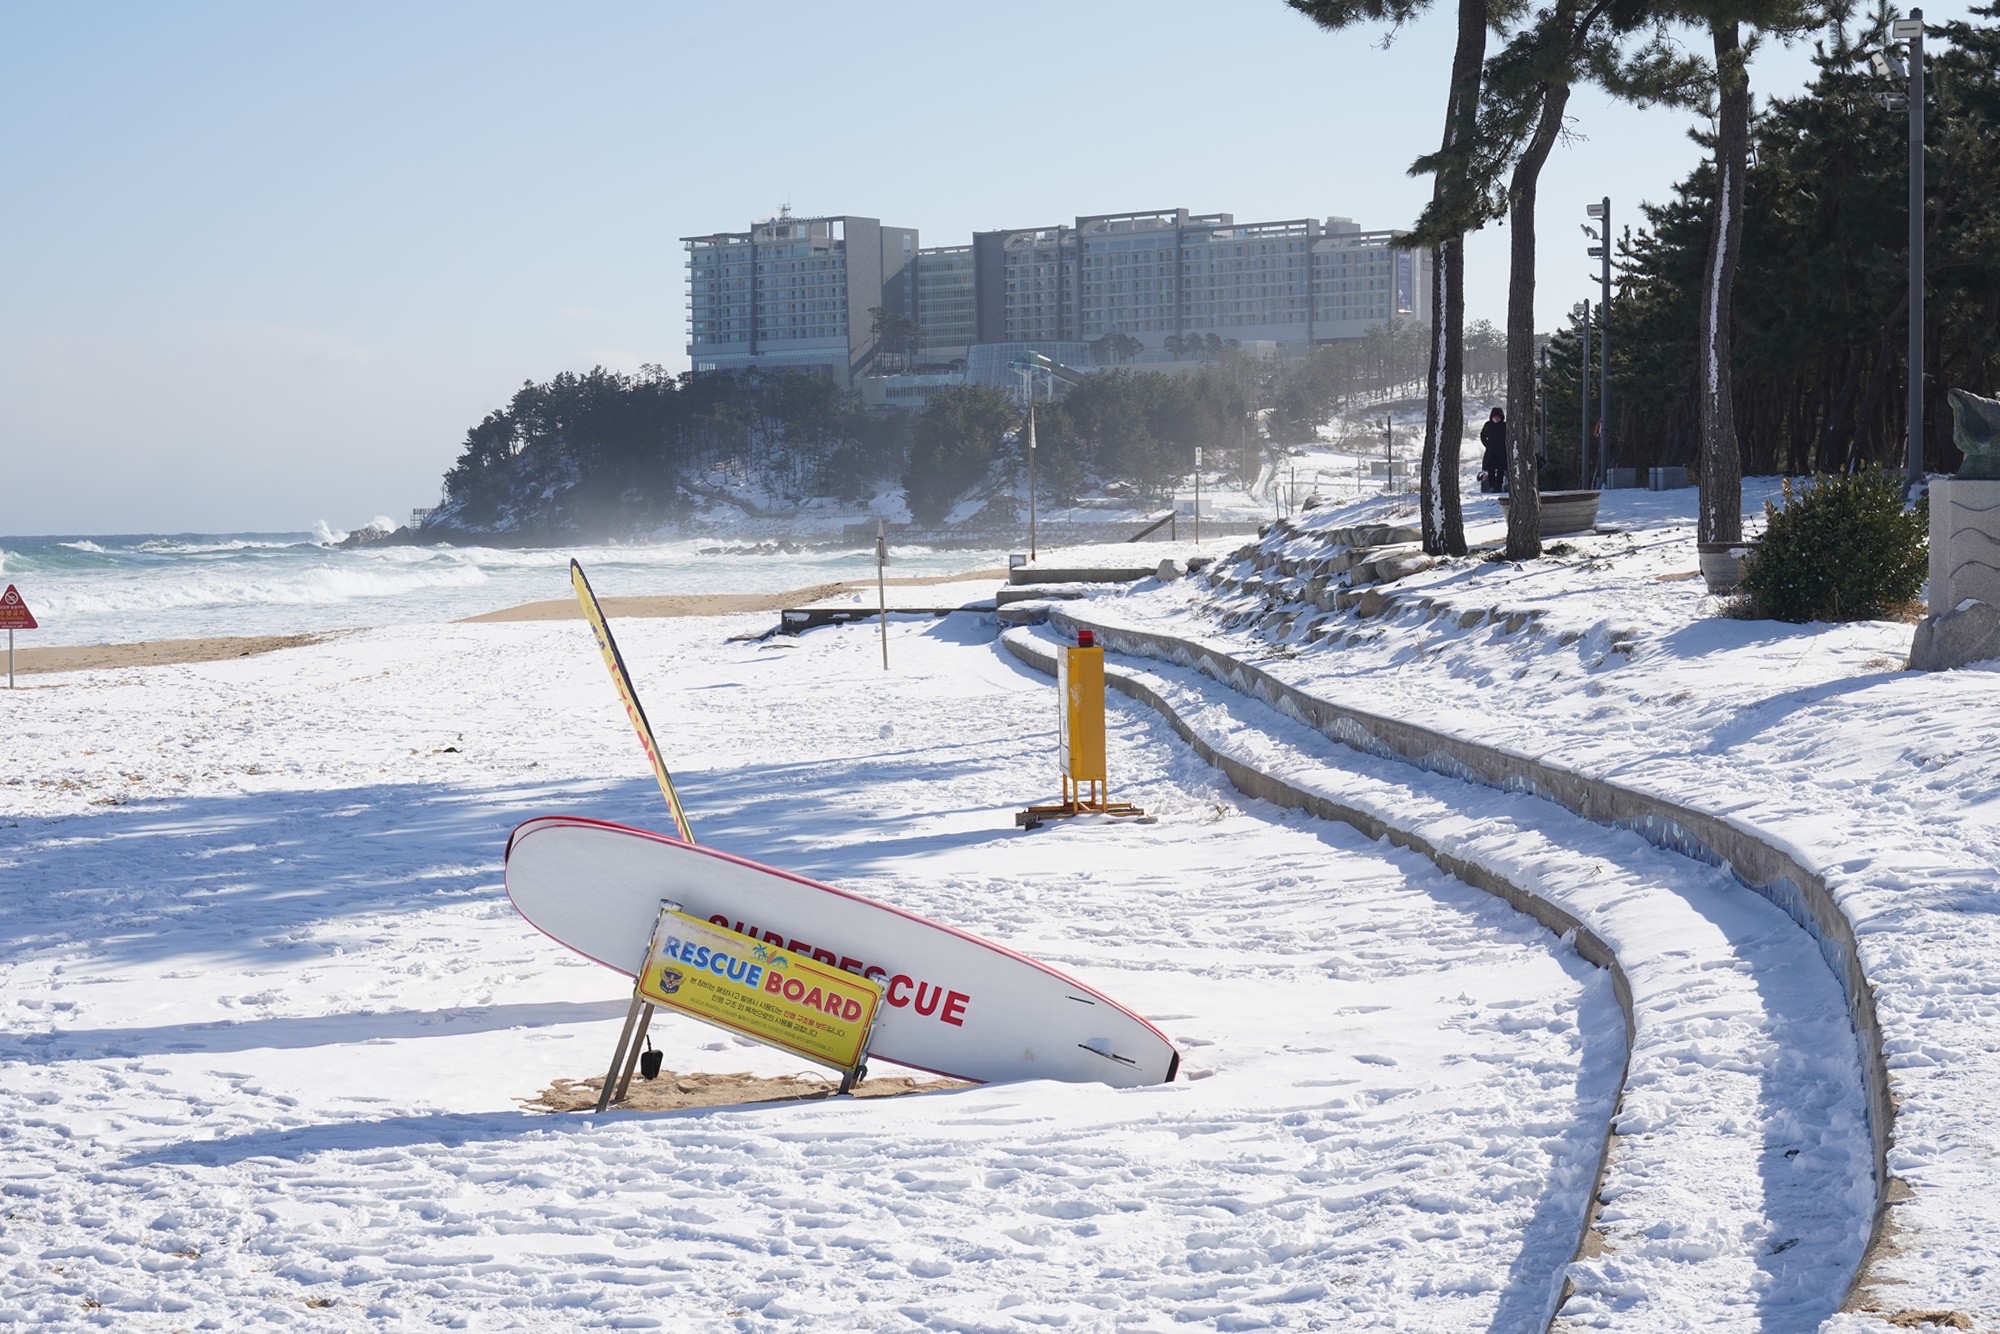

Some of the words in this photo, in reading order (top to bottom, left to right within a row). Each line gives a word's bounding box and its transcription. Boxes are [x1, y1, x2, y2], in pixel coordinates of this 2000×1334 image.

[662, 936, 762, 987] RESCUE
[764, 971, 863, 1022] BOARD
[690, 976, 698, 985] 본
[716, 986, 740, 1000] 해양사고
[724, 998, 737, 1008] 구조
[737, 1002, 745, 1011] 외
[774, 1016, 793, 1029] 사용을
